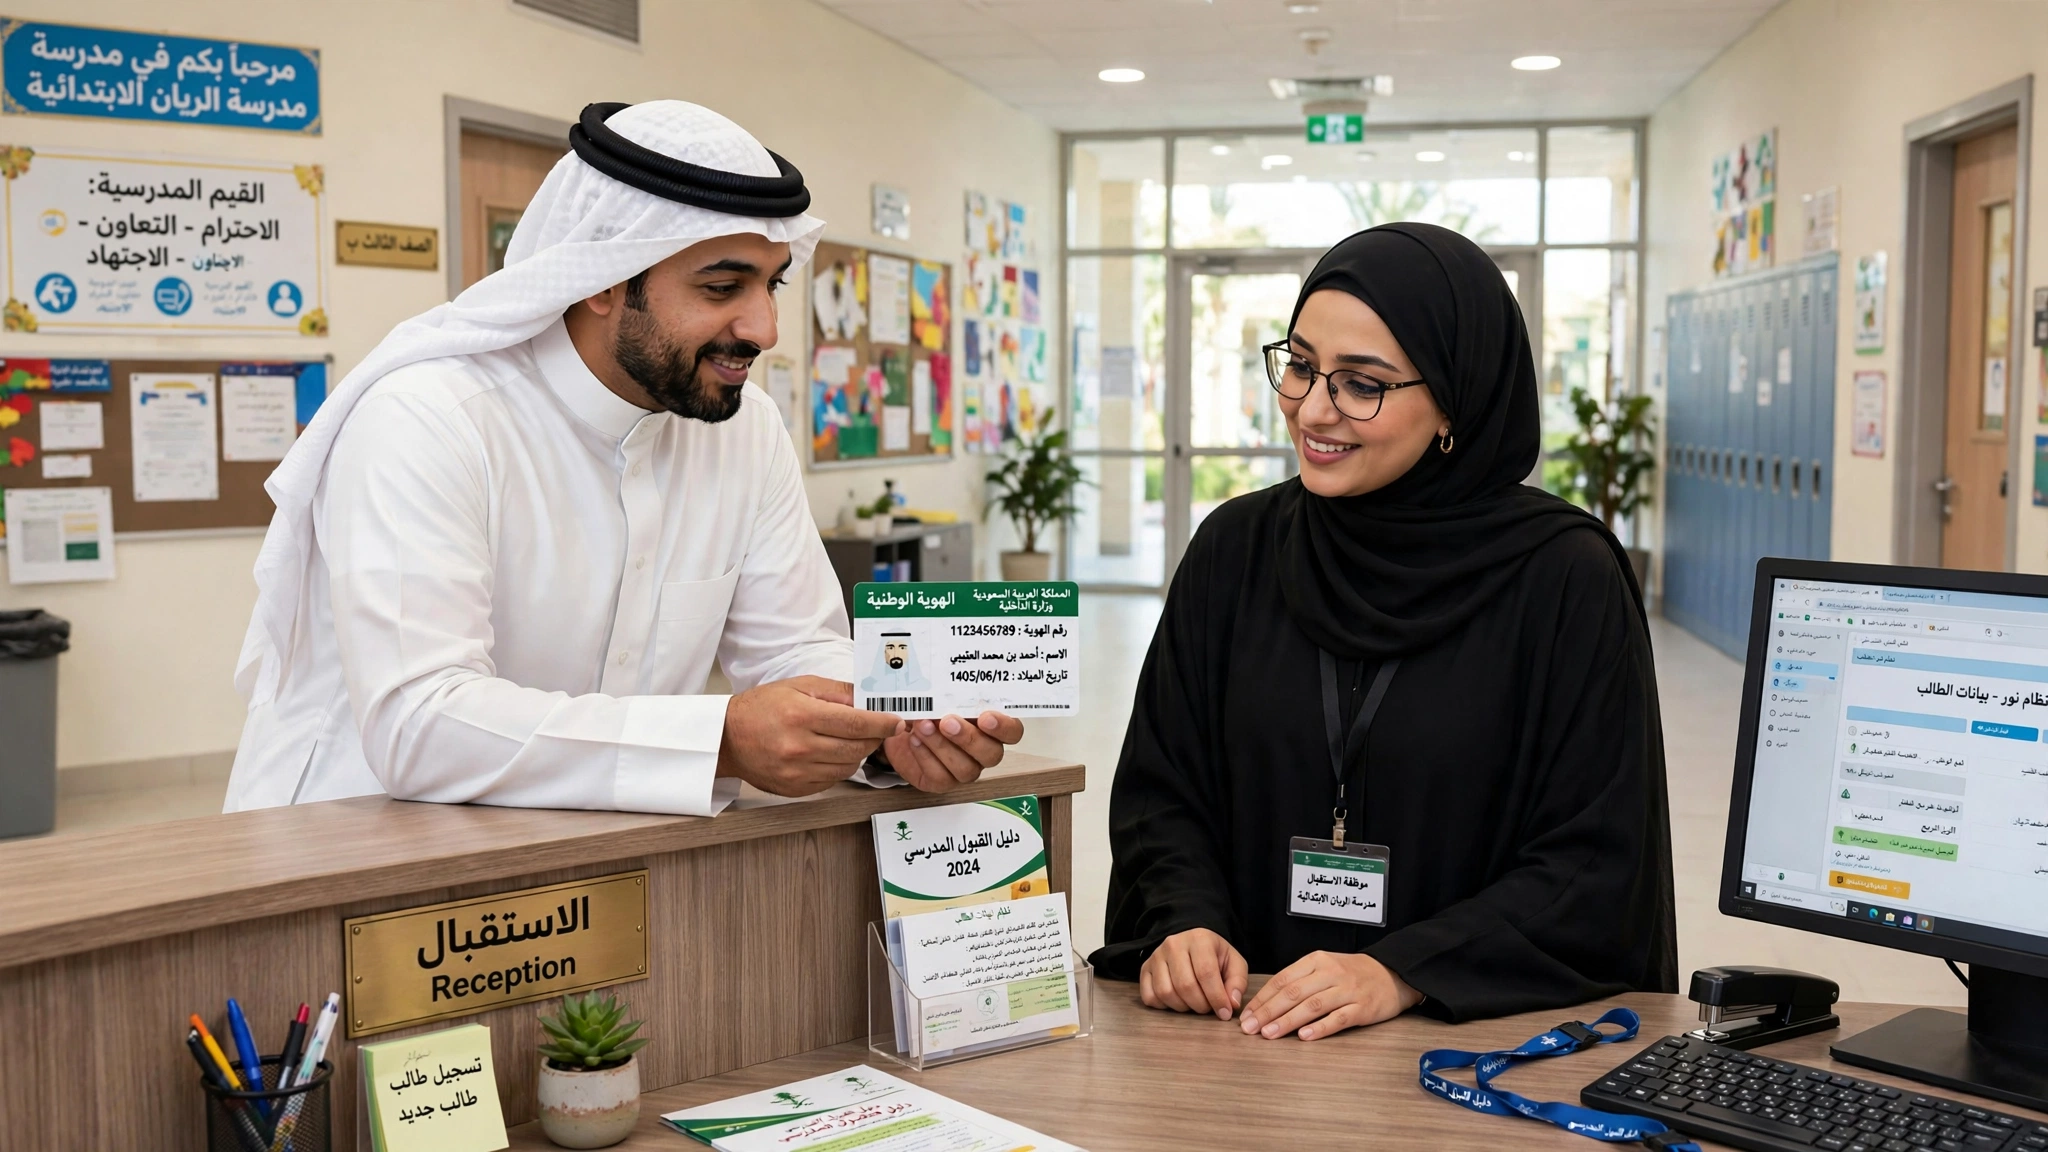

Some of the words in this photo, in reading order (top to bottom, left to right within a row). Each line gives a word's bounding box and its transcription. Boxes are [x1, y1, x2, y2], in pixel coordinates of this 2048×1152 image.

[31, 32, 123, 68] مدرسة
[130, 42, 170, 75] في
[177, 49, 223, 80] بكم
[229, 43, 295, 83] مرحباً
[27, 72, 143, 108] الابتدائية
[151, 86, 220, 118] الريان
[227, 89, 306, 119] مدرسة
[89, 173, 201, 203] المدرسية:
[209, 183, 264, 209] القيم
[96, 215, 176, 237] التعاون
[201, 217, 279, 246] الاحترام
[87, 245, 168, 271] الاجتهاد
[867, 591, 913, 609] الوطنية
[917, 591, 955, 609] الهوية
[973, 589, 1010, 602] السعودية
[1011, 589, 1038, 600] العربية
[1041, 588, 1071, 598] المملكة
[999, 599, 1030, 612] الداخلية
[1033, 600, 1053, 613] وزارة
[951, 625, 1015, 636] 1123456789
[1024, 624, 1050, 637] الهوية
[1052, 624, 1067, 637] رقم
[950, 650, 979, 665] العتيبي
[982, 652, 1004, 660] محمد
[1007, 651, 1017, 662] بن
[1019, 646, 1039, 659] أحمد
[1046, 649, 1067, 660] الاسم
[950, 671, 1009, 684] 1405/06/12
[1017, 670, 1044, 682] الميلاد
[1046, 671, 1068, 685] تاريخ
[1917, 682, 1953, 697] الطالب
[1956, 686, 1989, 704] بيانات
[2001, 692, 2019, 706] نور
[958, 834, 992, 854] القبول
[996, 829, 1020, 848] دليل
[904, 837, 954, 865] المدرسي
[947, 858, 980, 877] 2024
[1307, 873, 1341, 886] الاستقبال
[1344, 877, 1368, 890] موظفة
[1352, 897, 1376, 909] مدرسة
[417, 895, 589, 969] الاستقبال
[432, 956, 576, 1002] Reception
[433, 1057, 482, 1086] تسجيل
[390, 1070, 427, 1094] طالب
[440, 1089, 477, 1116] طالب
[399, 1102, 435, 1125] جديد
